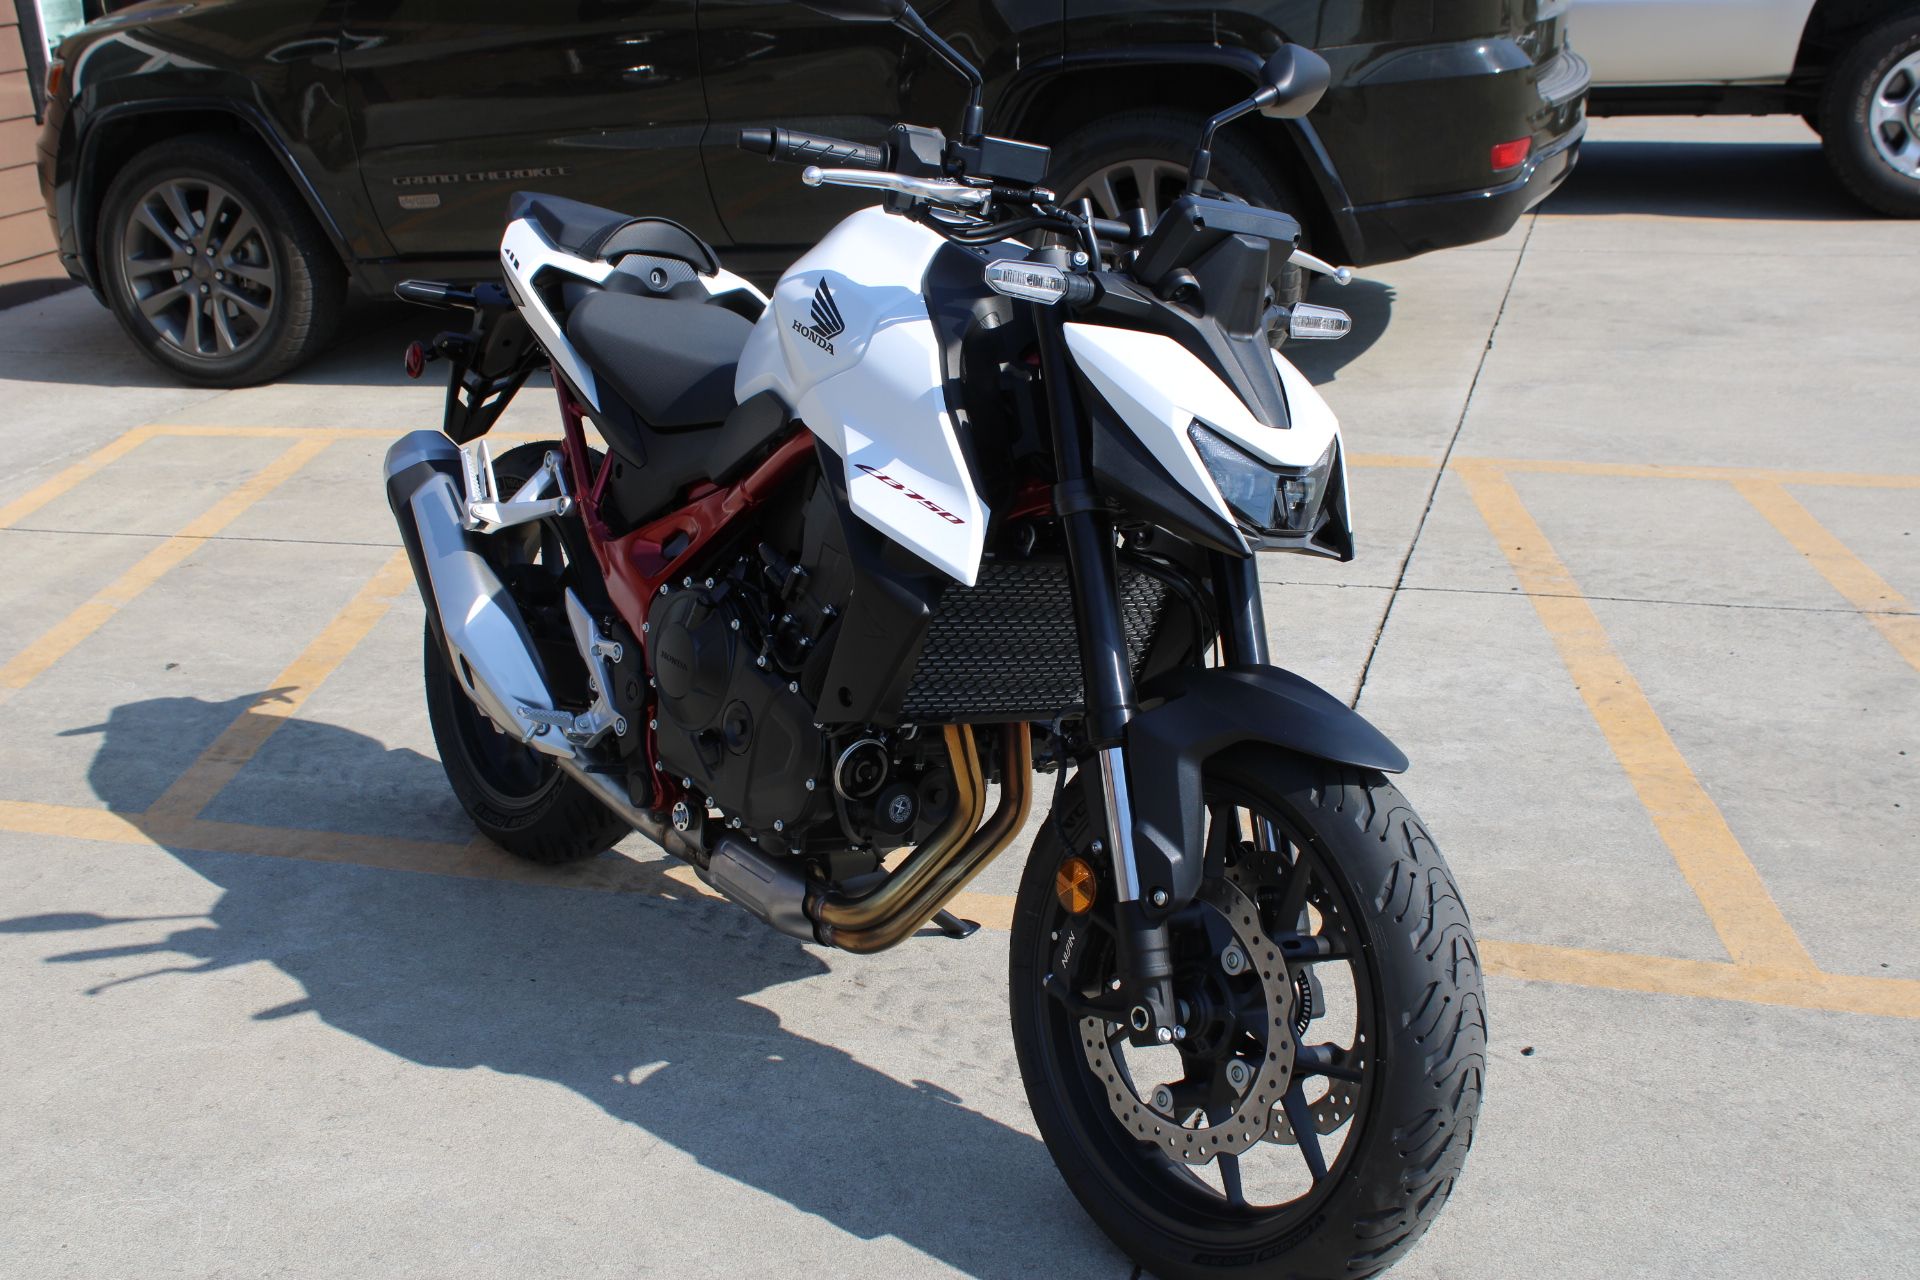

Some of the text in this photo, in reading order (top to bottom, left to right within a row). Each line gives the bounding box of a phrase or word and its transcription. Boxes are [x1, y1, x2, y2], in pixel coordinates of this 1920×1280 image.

[392, 174, 458, 185] GRAND
[792, 319, 834, 355] HONDA
[660, 650, 689, 671] HONDA
